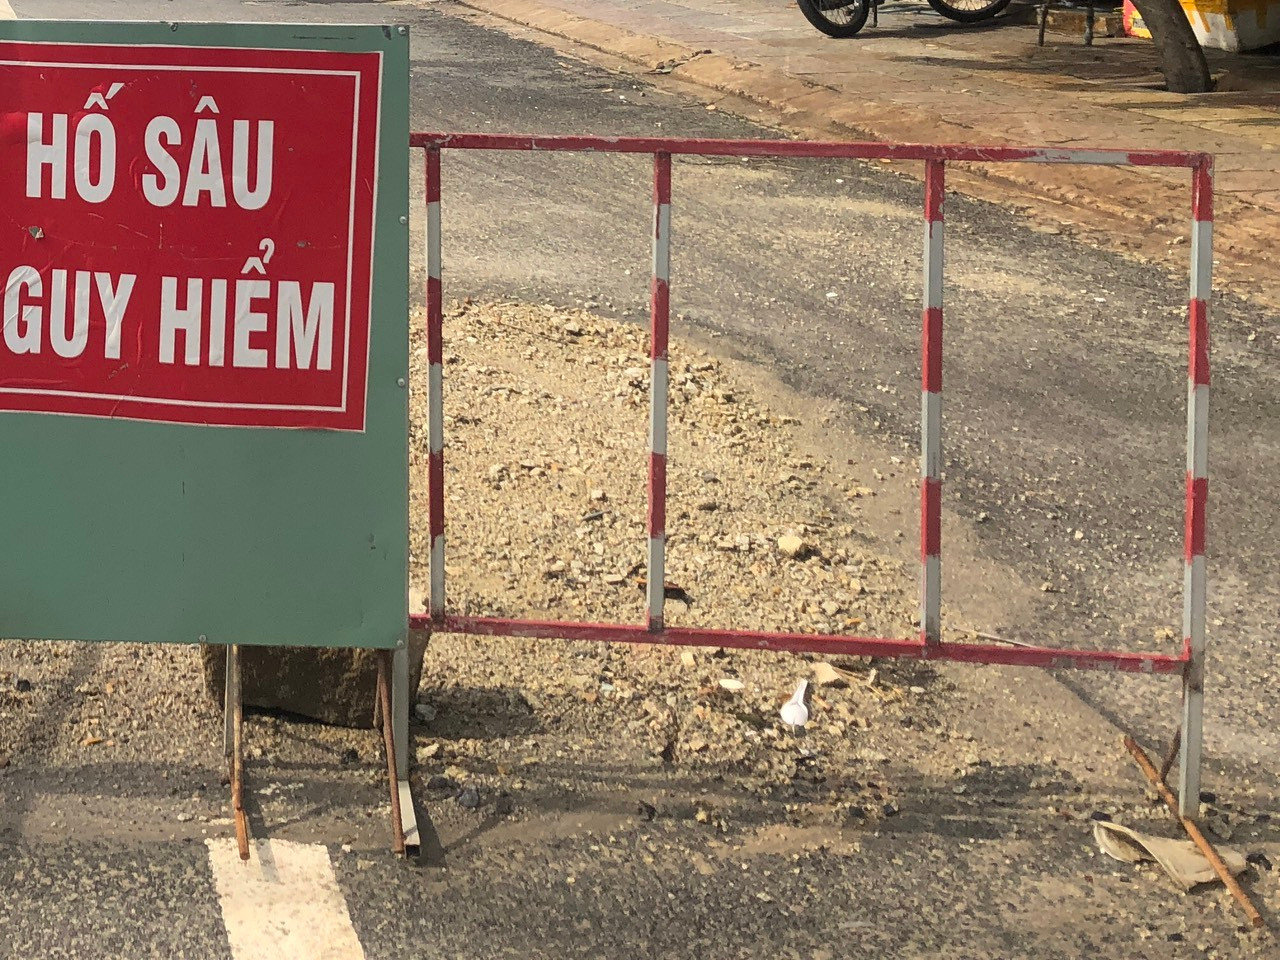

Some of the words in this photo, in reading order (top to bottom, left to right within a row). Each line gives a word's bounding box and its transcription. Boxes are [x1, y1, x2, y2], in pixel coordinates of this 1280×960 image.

[25, 82, 125, 204] HỐ
[142, 95, 275, 210] SÂU
[158, 238, 335, 371] HIỂM
